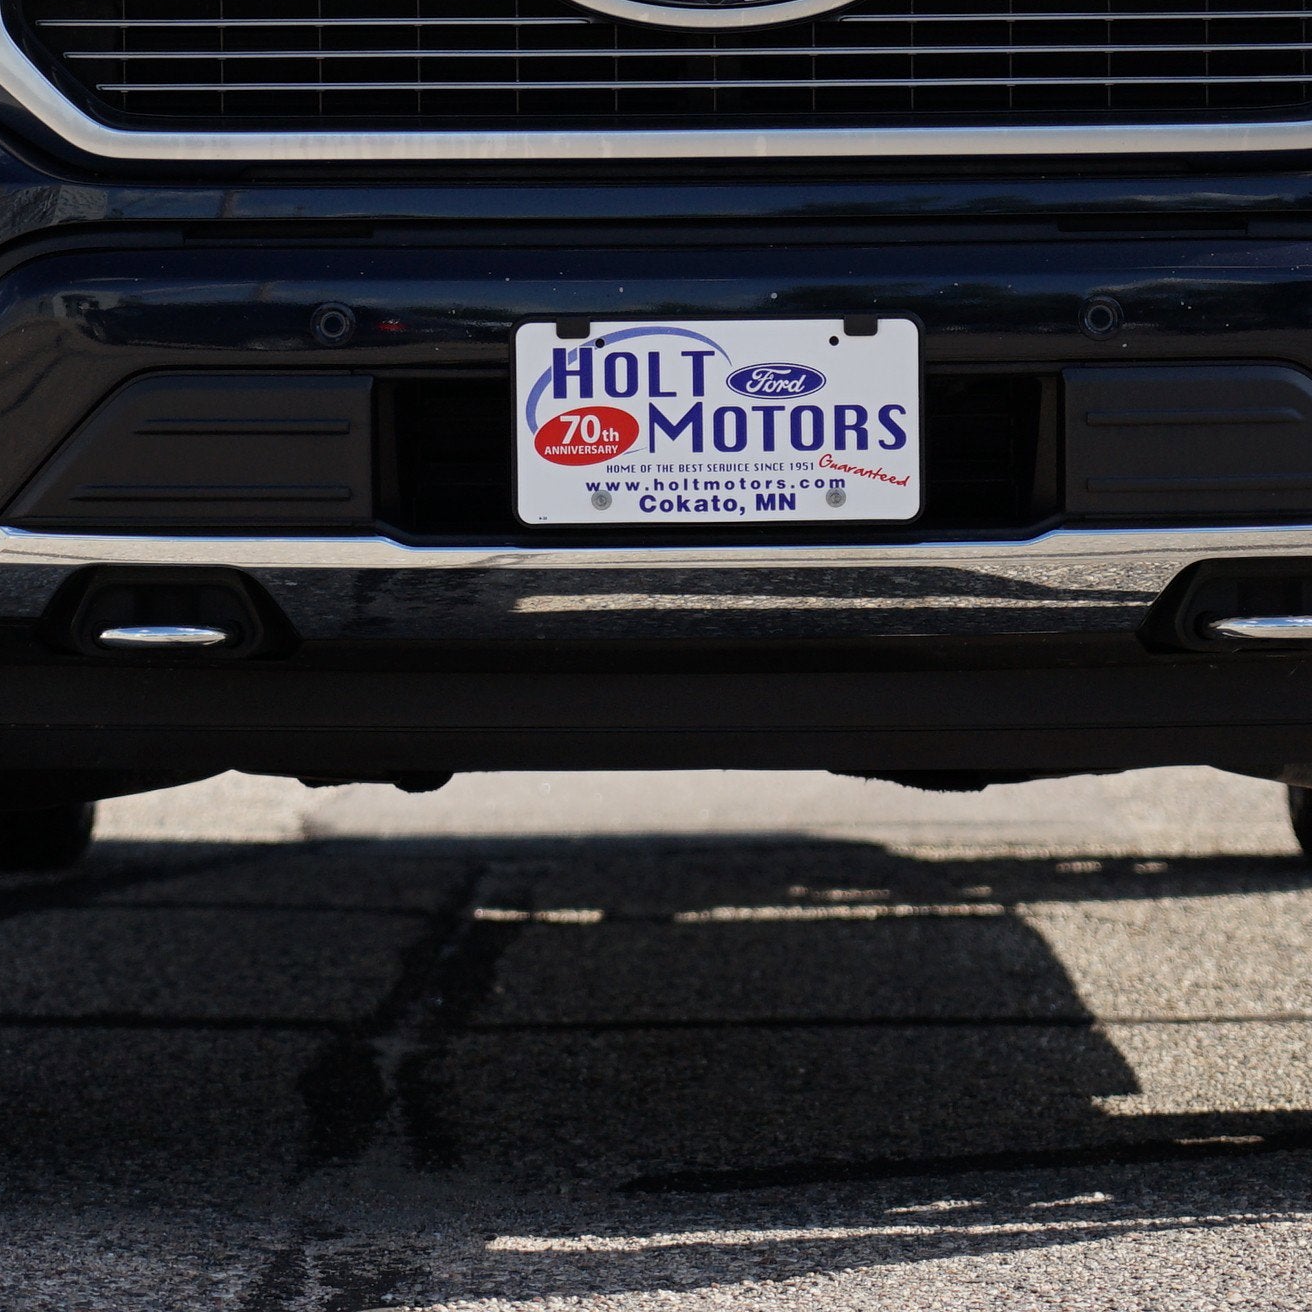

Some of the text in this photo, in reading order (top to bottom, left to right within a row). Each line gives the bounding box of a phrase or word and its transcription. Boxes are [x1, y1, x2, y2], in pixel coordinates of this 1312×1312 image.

[552, 347, 715, 399] HOLT
[745, 368, 807, 393] Ford
[559, 414, 620, 445] 70th
[648, 401, 907, 454] MOTORS
[544, 444, 619, 455] ANNIVERSARY
[606, 461, 815, 474] HOME OF THE BEST SERVICE SINCE 1951
[818, 453, 911, 487] Guaranteed
[585, 477, 846, 492] www.holtmotors.com
[639, 493, 797, 516] Cokato, MN
